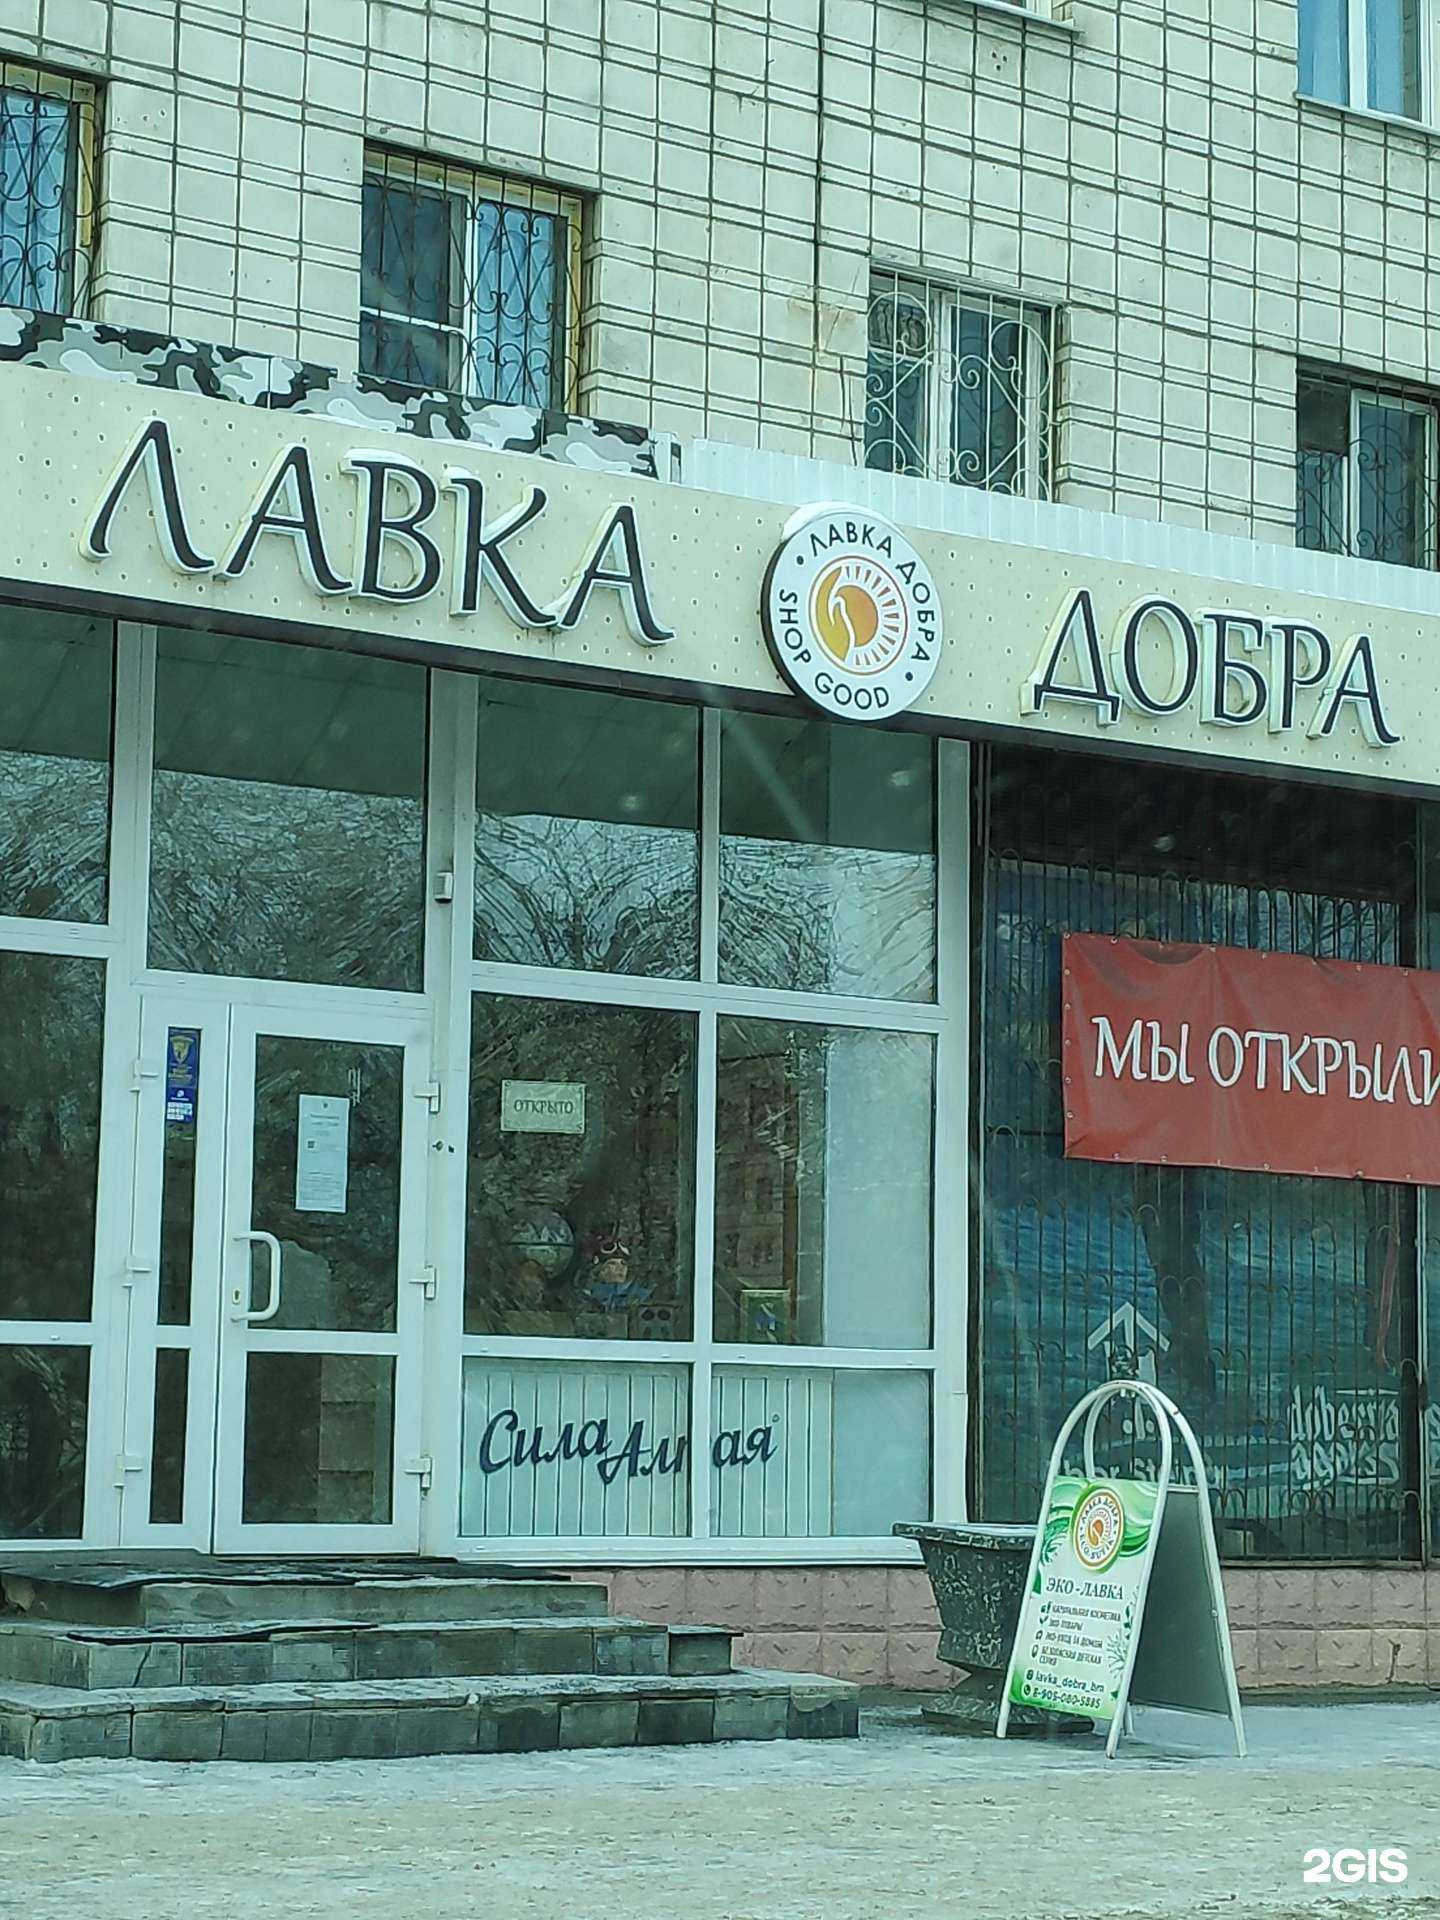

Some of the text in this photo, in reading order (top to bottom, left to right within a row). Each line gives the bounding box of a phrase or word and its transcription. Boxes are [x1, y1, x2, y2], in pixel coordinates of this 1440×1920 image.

[80, 417, 1400, 747] ЛАВКА ДОБРА
[810, 521, 936, 662] ЛАВКА ДОБРА
[779, 589, 890, 709] SHOP GOOD
[1092, 1016, 1195, 1084] МЫ
[514, 1099, 574, 1115] ОТКРЫТО
[480, 1409, 777, 1485] Сила Алая
